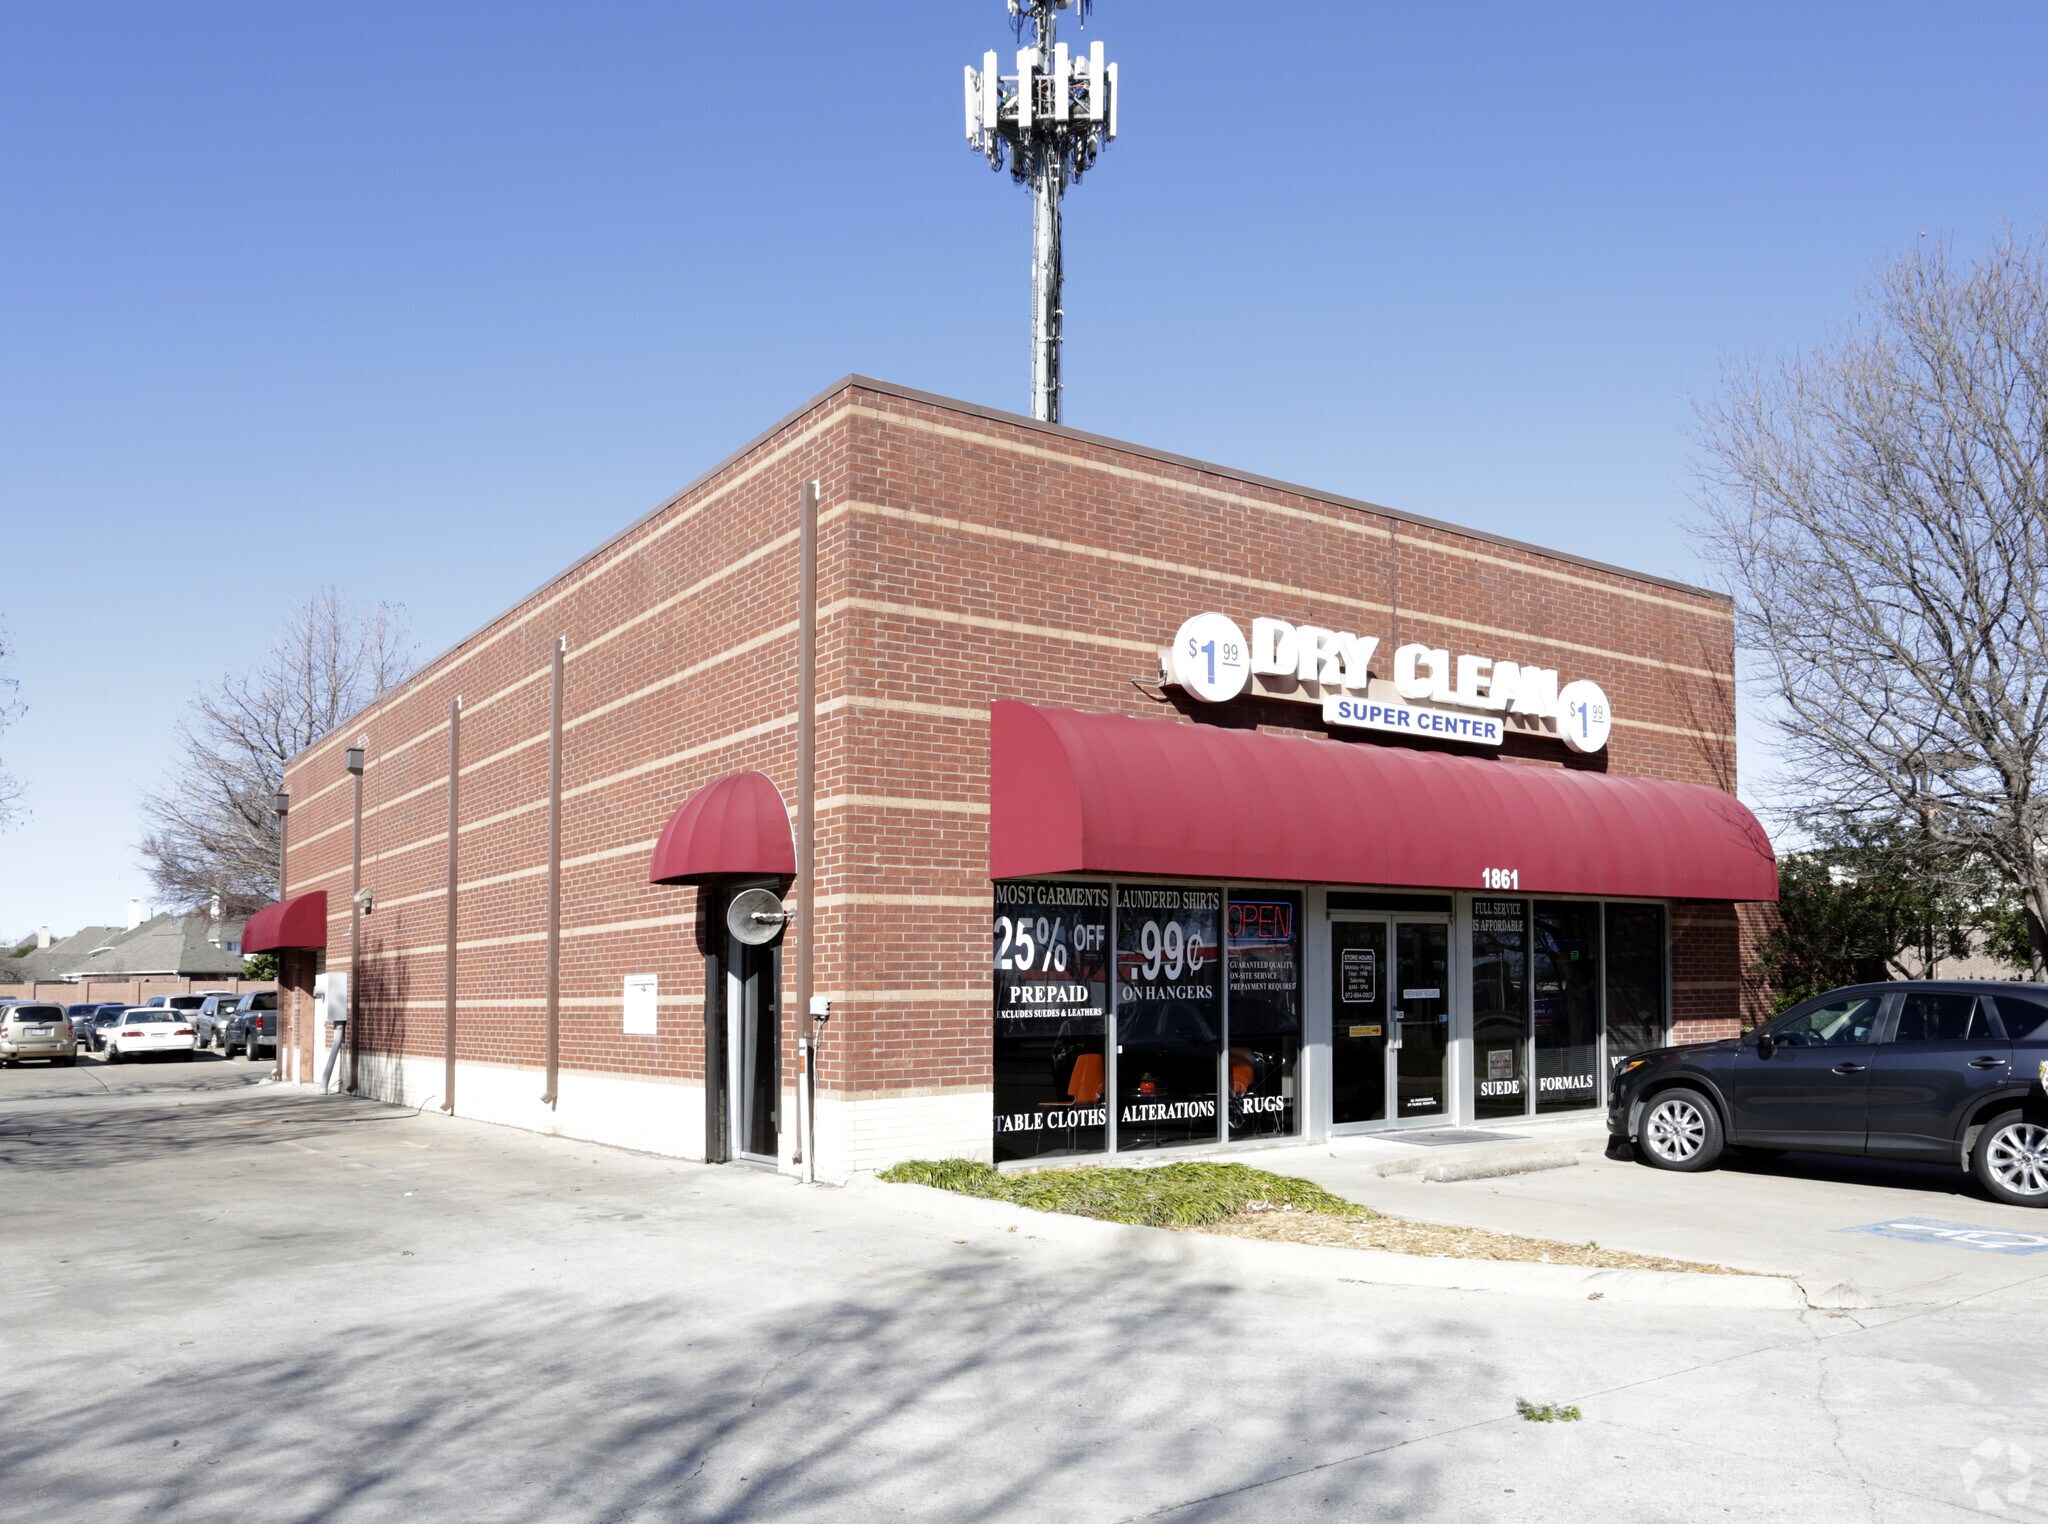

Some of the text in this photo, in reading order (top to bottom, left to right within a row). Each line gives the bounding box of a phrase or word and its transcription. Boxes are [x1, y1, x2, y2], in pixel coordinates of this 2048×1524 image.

[1250, 617, 1558, 717] DRY CLEAN
[1338, 701, 1496, 739] SUPER CENTER
[1482, 868, 1519, 890] 1861
[996, 885, 1109, 907] MOST GARMENTS
[1116, 890, 1219, 910] LAUNDERED SHIRTS
[1475, 902, 1521, 915] FULL SERVICE
[1227, 905, 1289, 936] OPEN
[1473, 919, 1524, 932] IS AFFORDABLE
[994, 916, 1105, 972] 25% OFF
[1229, 961, 1293, 969] GUARANTEED QUALITY
[1009, 985, 1088, 1003] PREPAID
[1122, 985, 1212, 1000] ON HANGERS
[1268, 982, 1296, 991] REQUIRED
[997, 1009, 1033, 1018] EXCLUDES
[1034, 1009, 1060, 1018] SUEDES
[1068, 1008, 1102, 1016] LEATHERS
[1481, 1080, 1520, 1096] SUEDE
[1540, 1075, 1594, 1092] FORMALS
[1121, 1101, 1215, 1122] ALTERATIONS
[1242, 1096, 1284, 1114] RUGS
[995, 1108, 1106, 1132] TABLE CLOTHS
